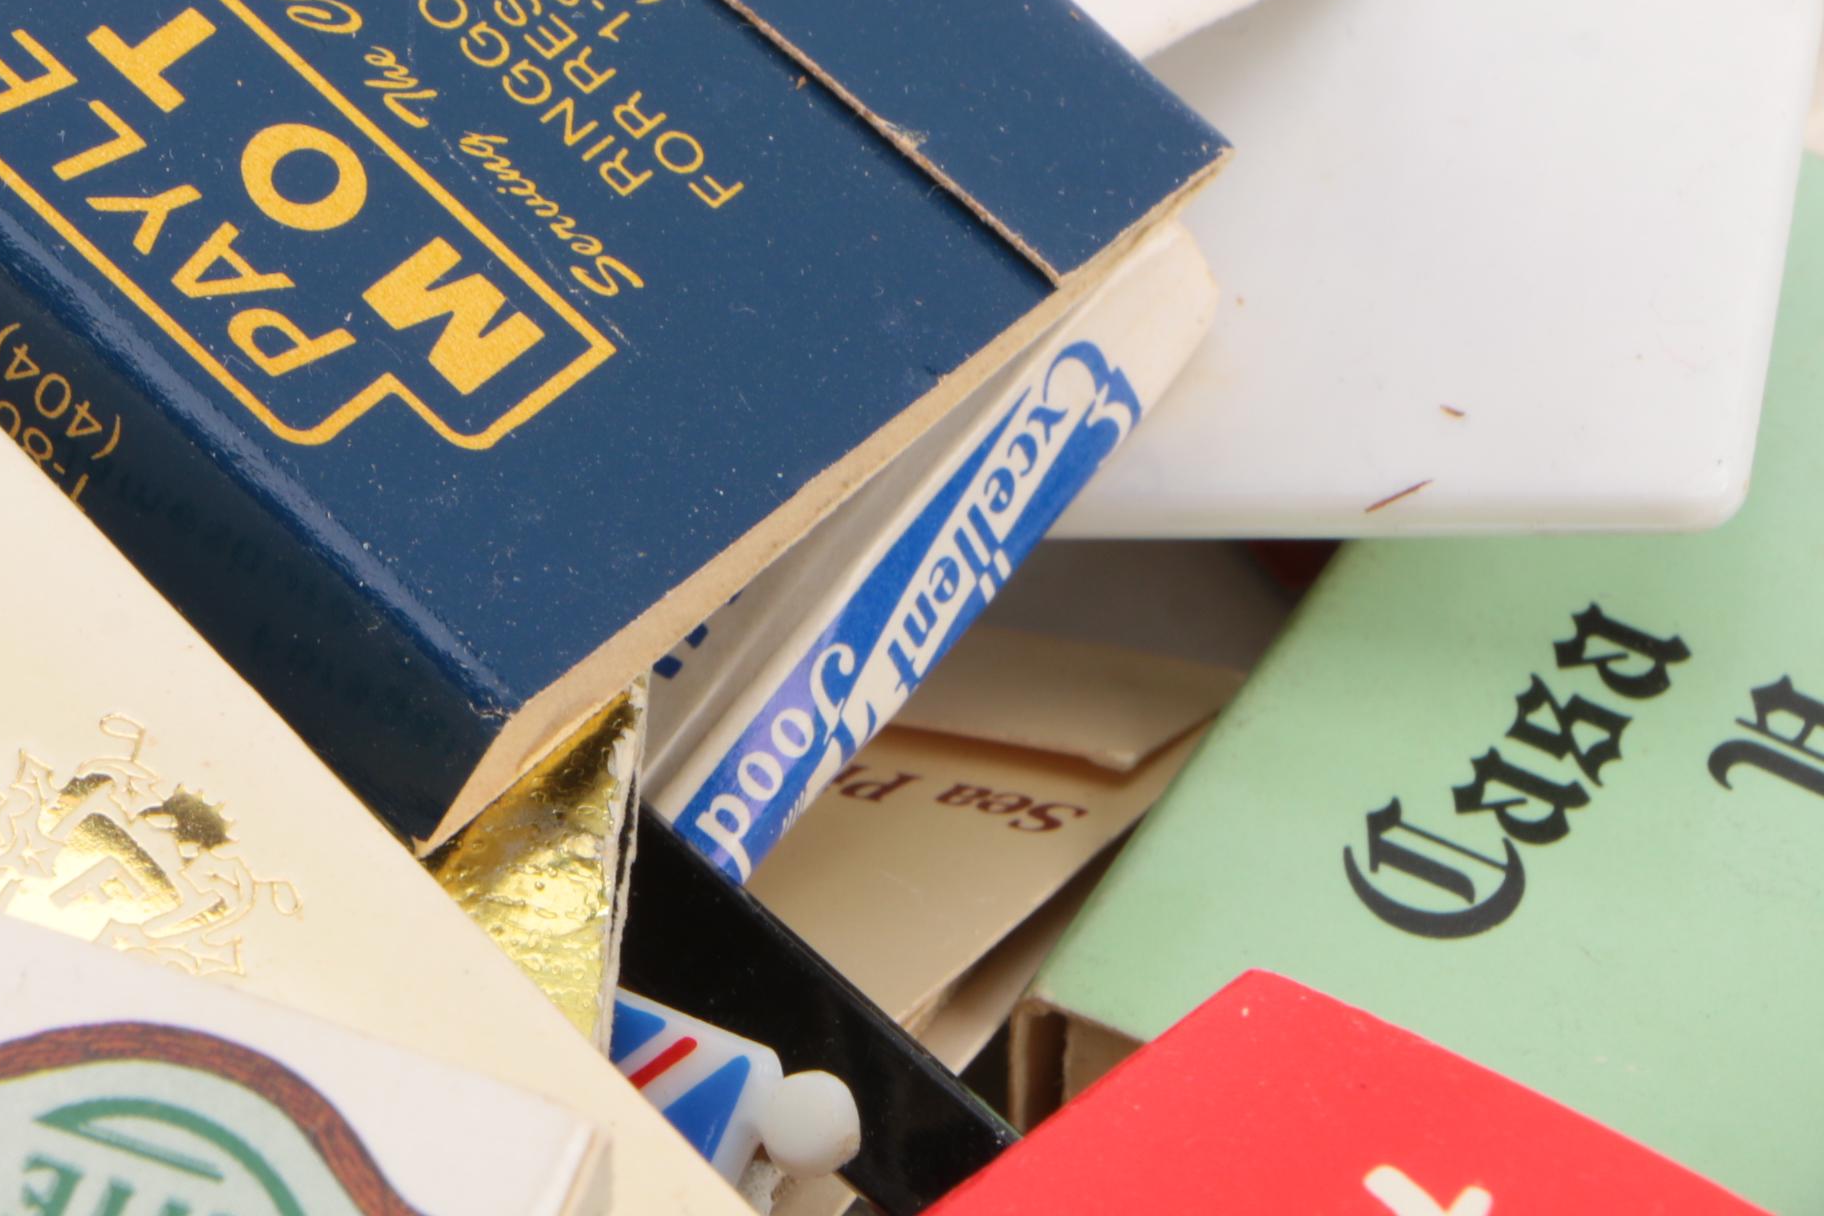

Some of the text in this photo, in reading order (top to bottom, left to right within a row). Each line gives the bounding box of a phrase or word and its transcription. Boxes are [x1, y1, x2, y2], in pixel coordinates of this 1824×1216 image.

[363, 46, 437, 128] The
[613, 90, 745, 210] FOR
[460, 131, 644, 297] Serving
[694, 340, 1142, 885] Excellent Food
[935, 781, 1089, 835] Sea
[1343, 601, 1691, 940] Casa
